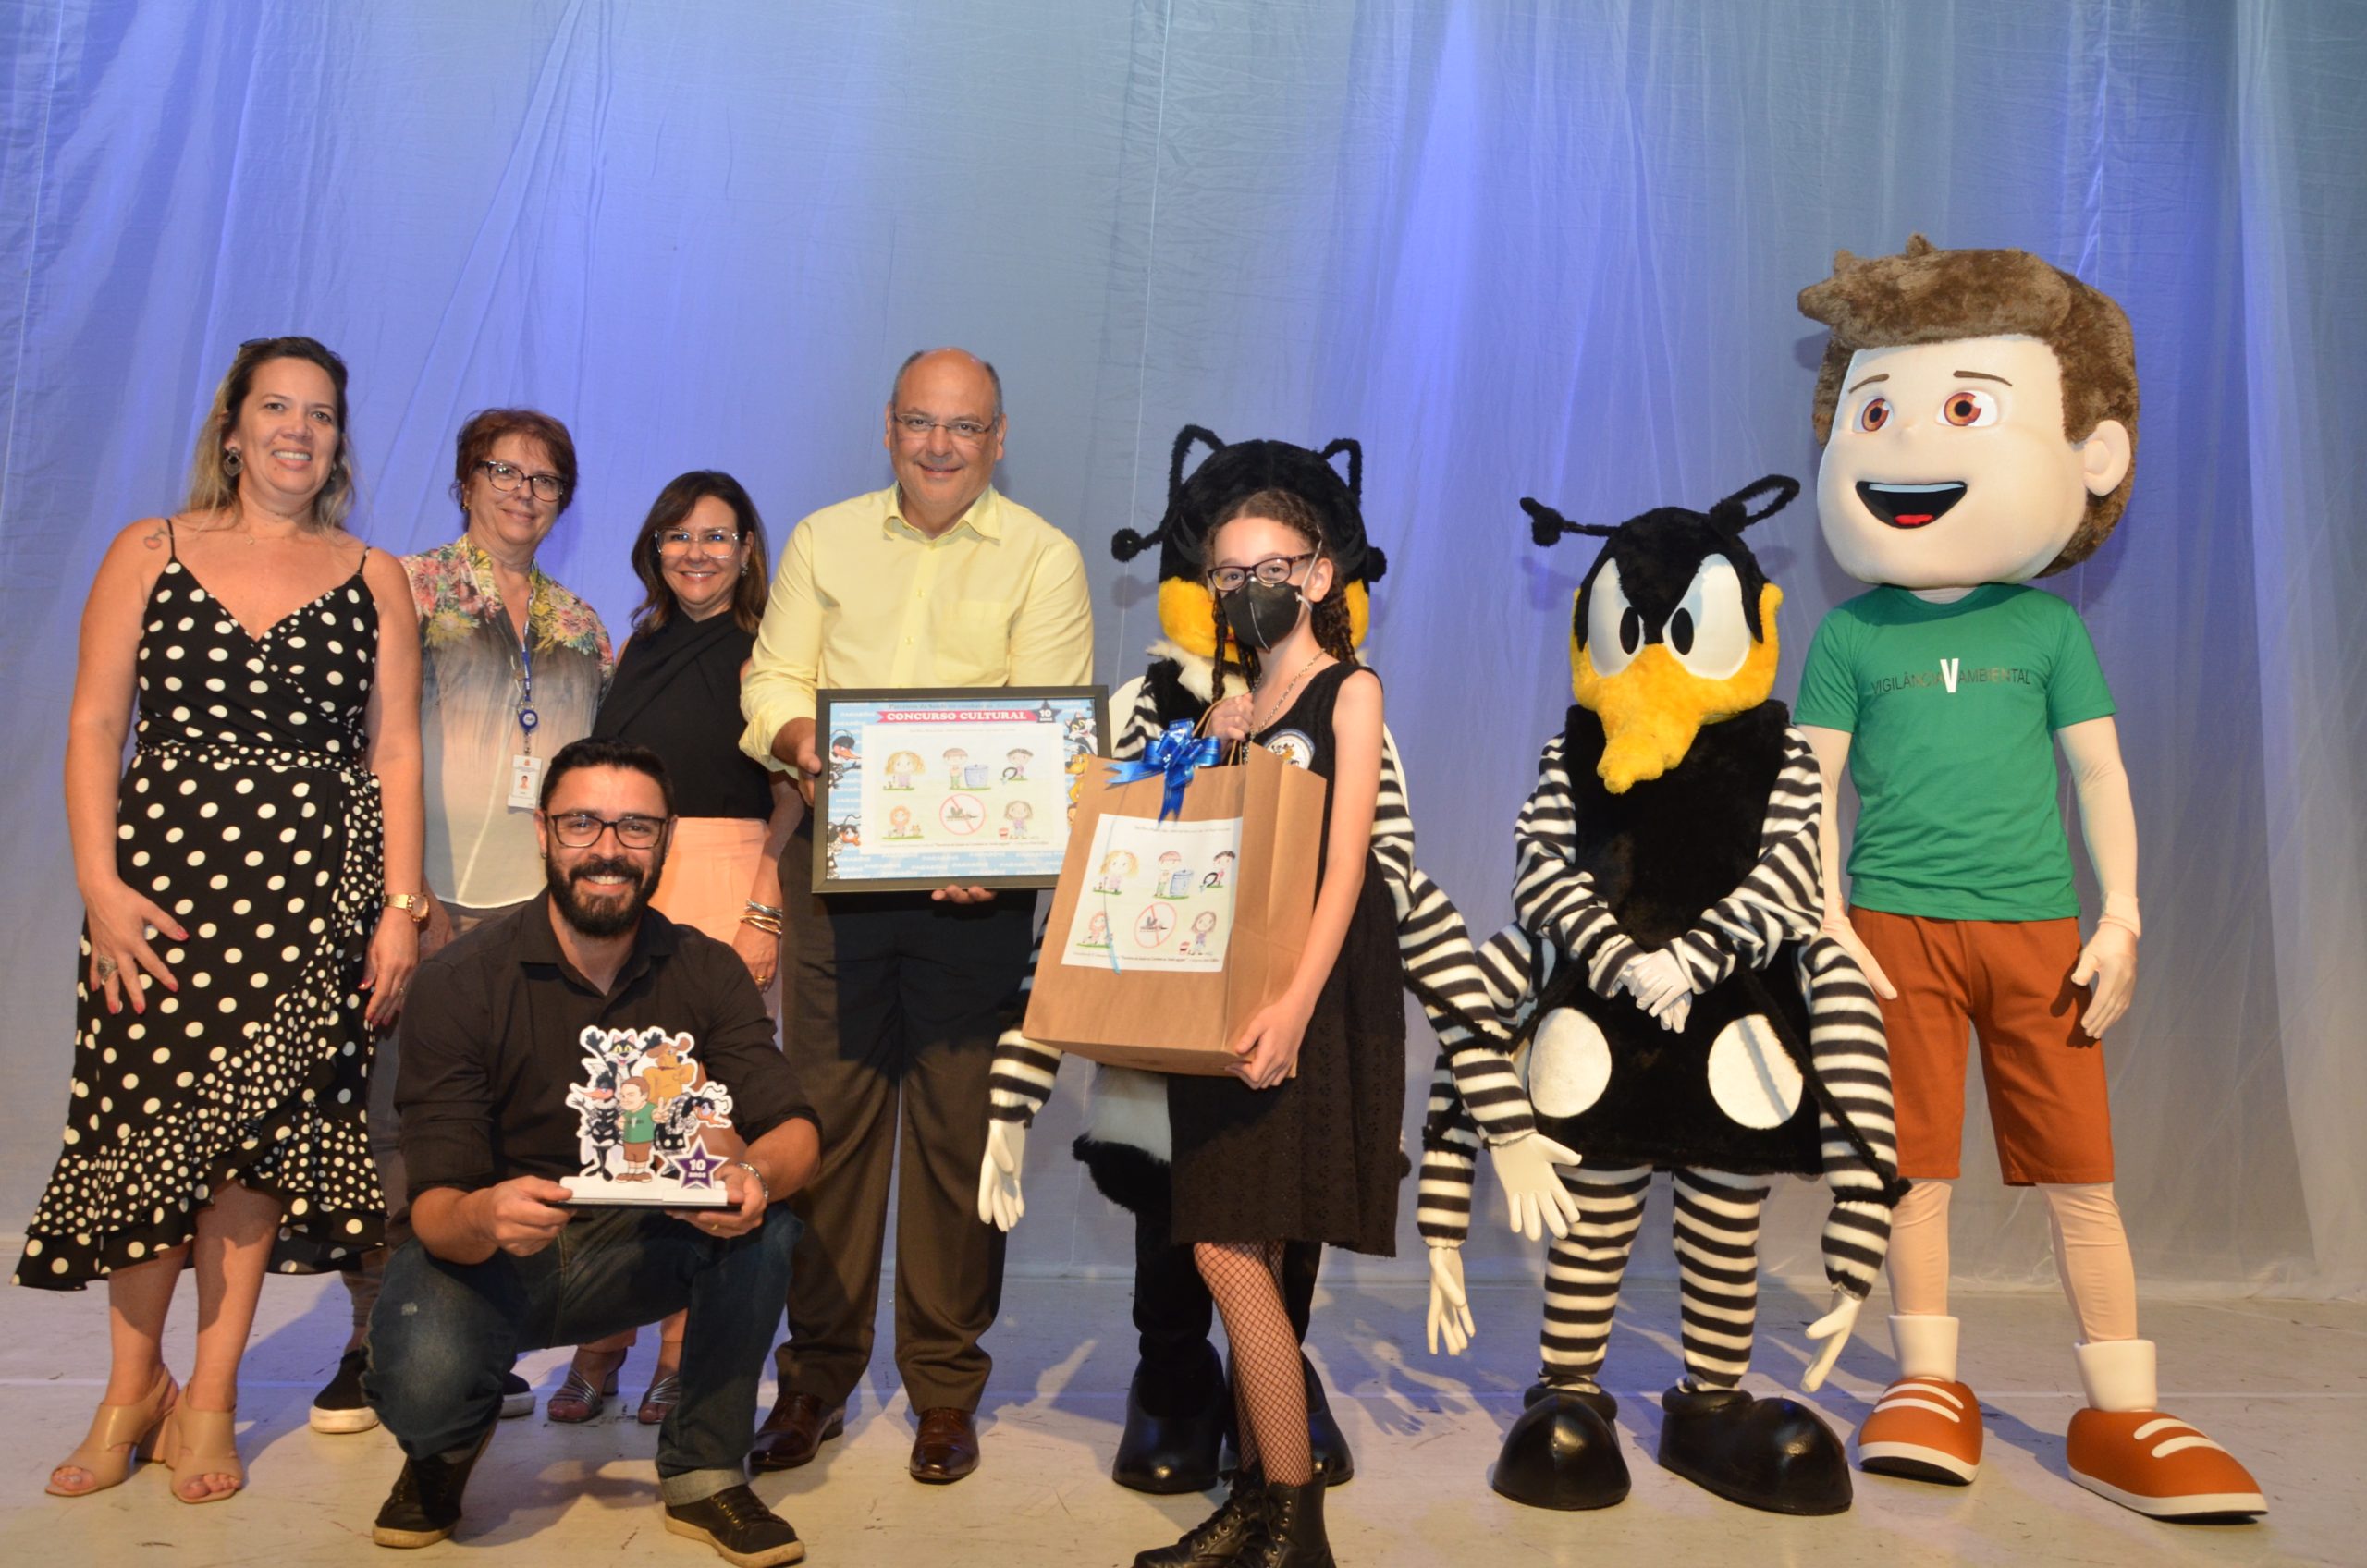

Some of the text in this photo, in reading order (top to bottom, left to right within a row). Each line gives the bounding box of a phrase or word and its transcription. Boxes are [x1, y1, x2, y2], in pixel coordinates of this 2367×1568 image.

[1940, 658, 1959, 693] V
[1958, 668, 2031, 685] AMBIENTAL
[887, 711, 1027, 721] CONCURSO CULTURAL
[1039, 709, 1052, 717] 10
[689, 1158, 706, 1171] 10
